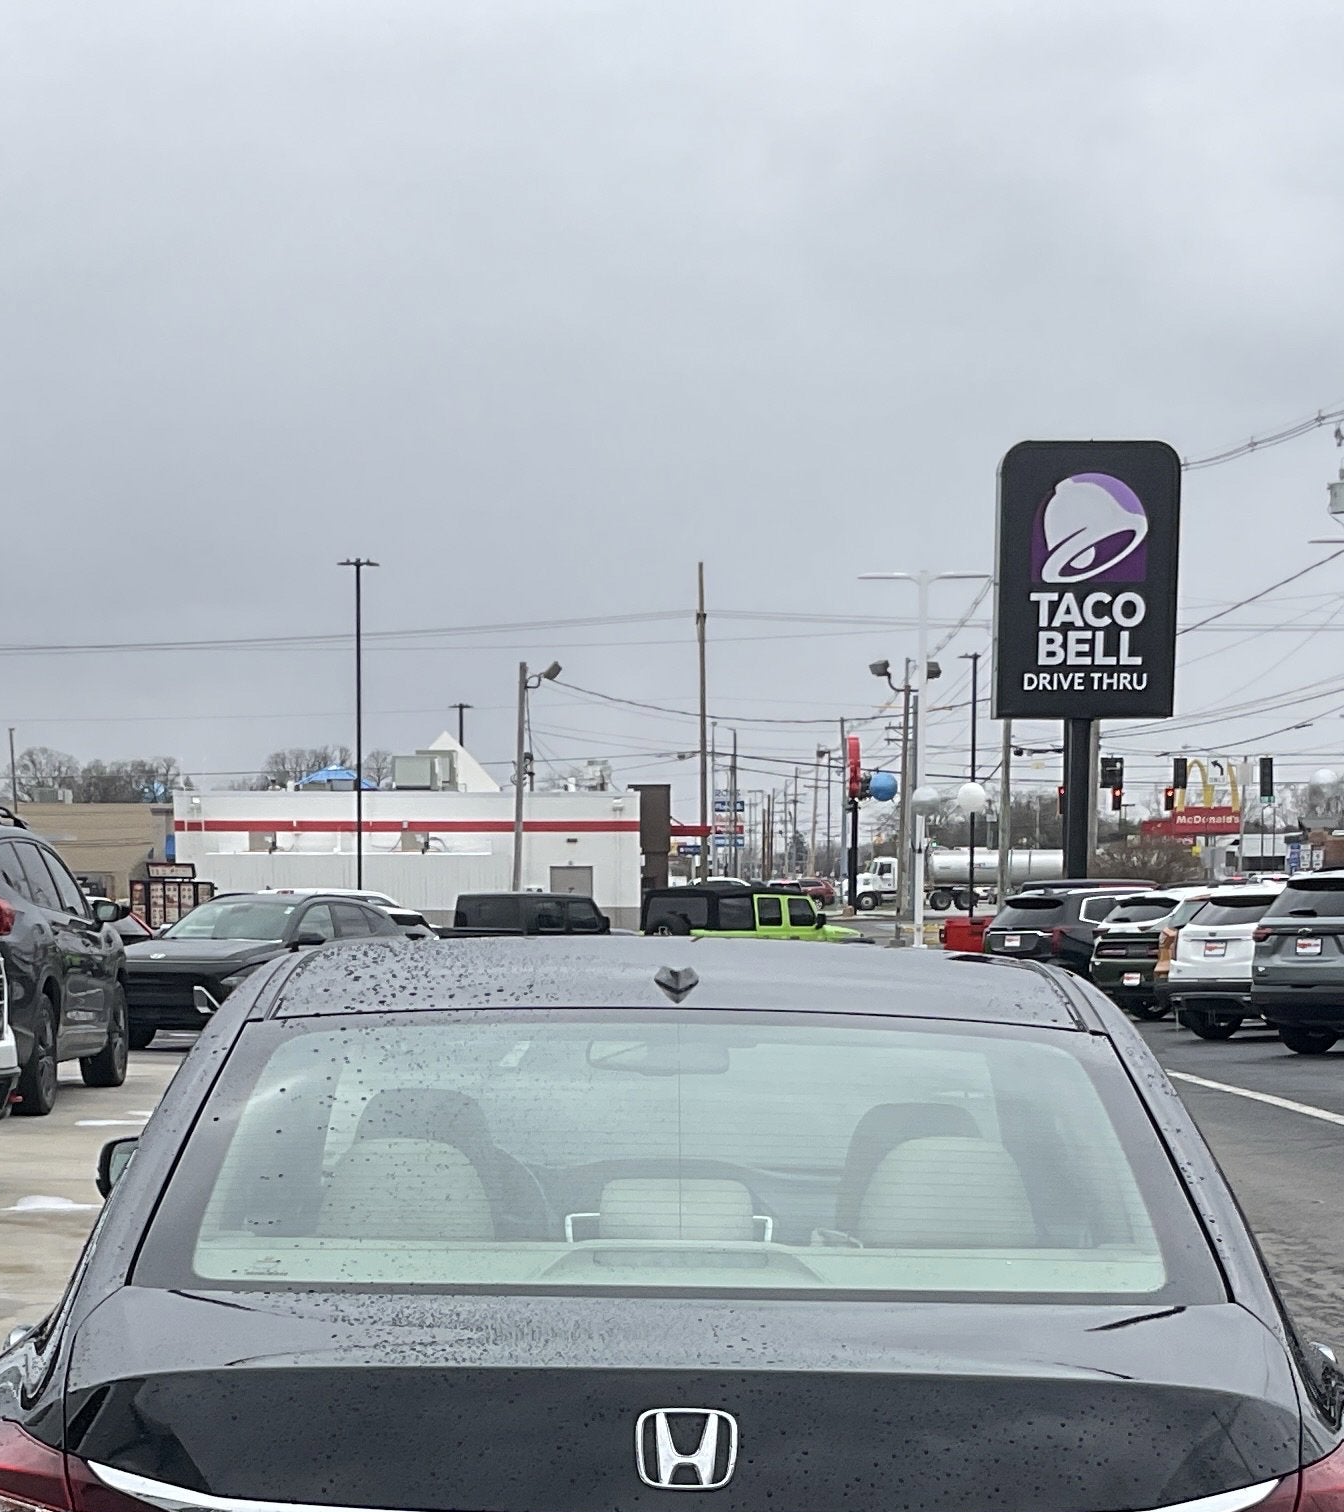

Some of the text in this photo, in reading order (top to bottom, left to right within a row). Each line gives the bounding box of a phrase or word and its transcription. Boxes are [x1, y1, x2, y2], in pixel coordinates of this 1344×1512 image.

[1029, 592, 1146, 628] TACO
[1037, 630, 1143, 666] BELL
[1023, 673, 1148, 691] DRIVE THRU
[1176, 815, 1240, 825] McDonald's
